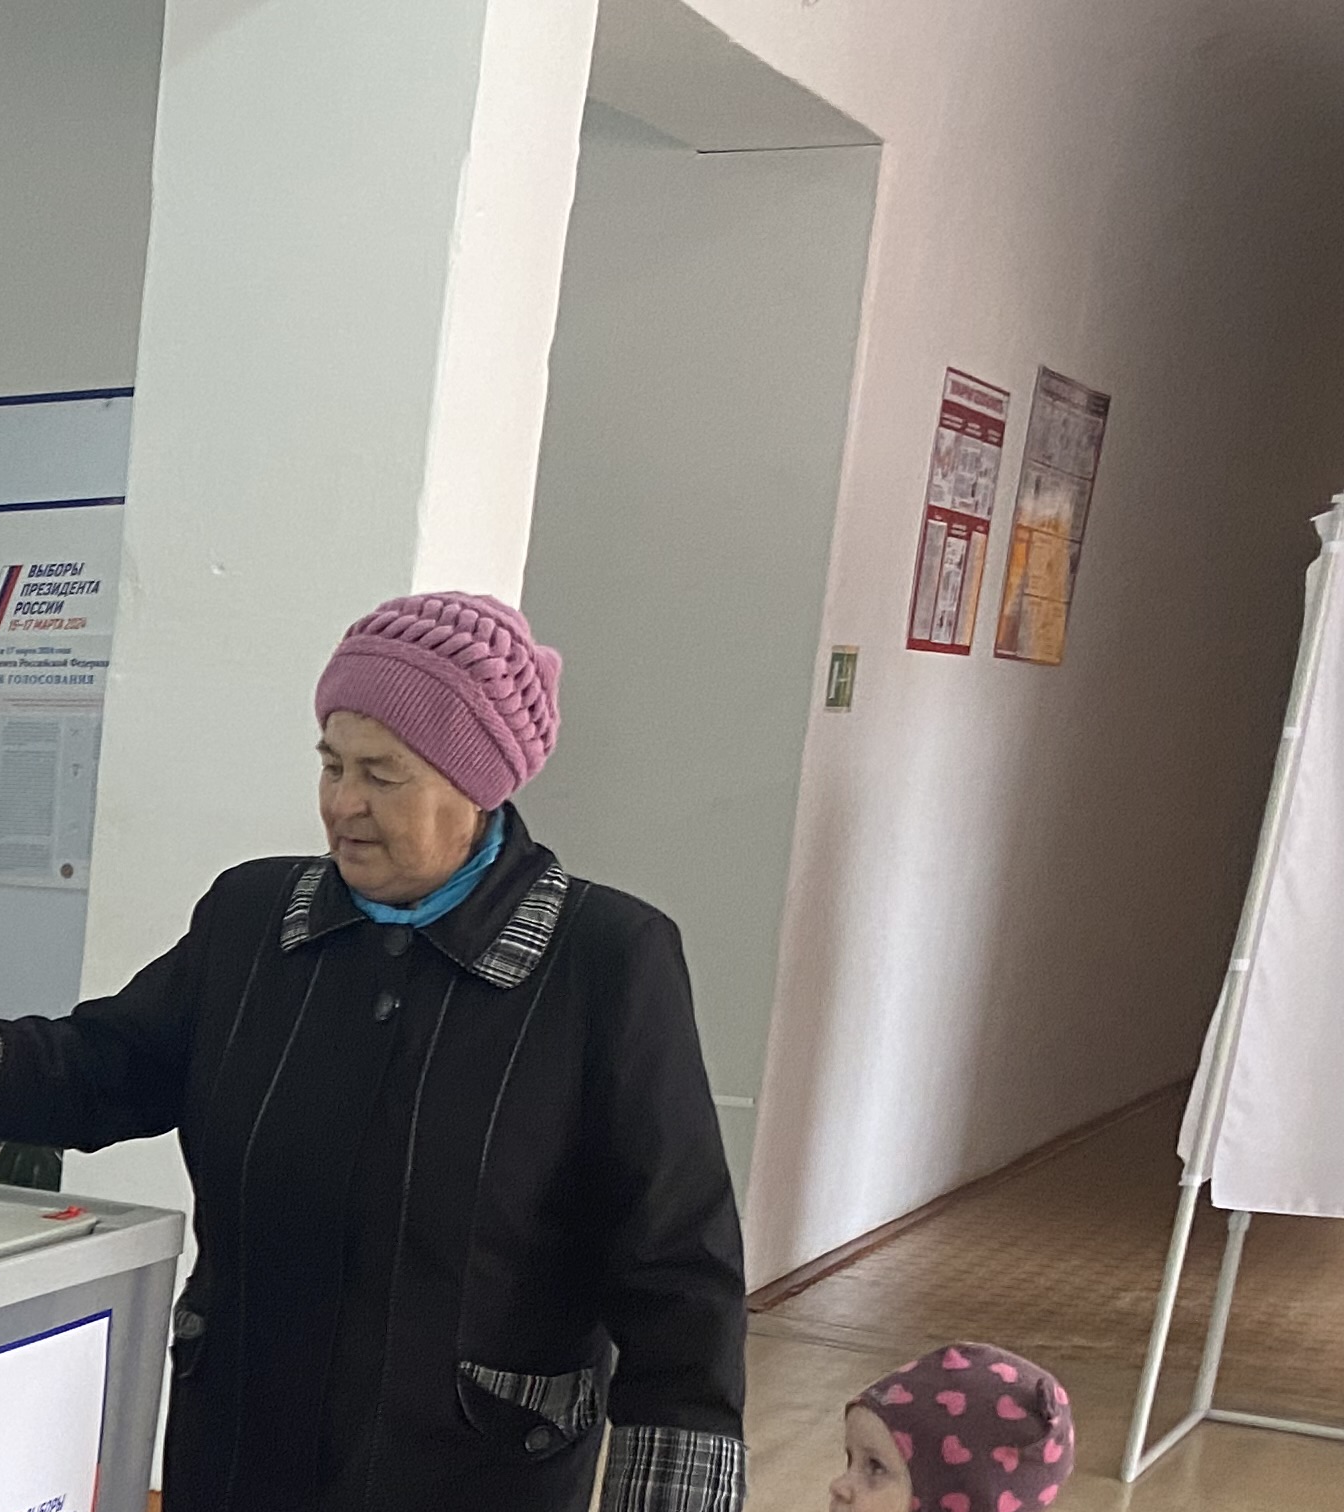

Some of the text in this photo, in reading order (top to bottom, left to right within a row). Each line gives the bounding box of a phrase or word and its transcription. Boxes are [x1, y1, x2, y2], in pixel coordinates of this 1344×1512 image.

[27, 562, 86, 579] ВЫБОРЫ
[20, 580, 102, 597] ПРЕЗИДЕНТА
[13, 600, 65, 616] РОССИИ
[8, 674, 94, 685] ГОЛОСОВАНИЯ
